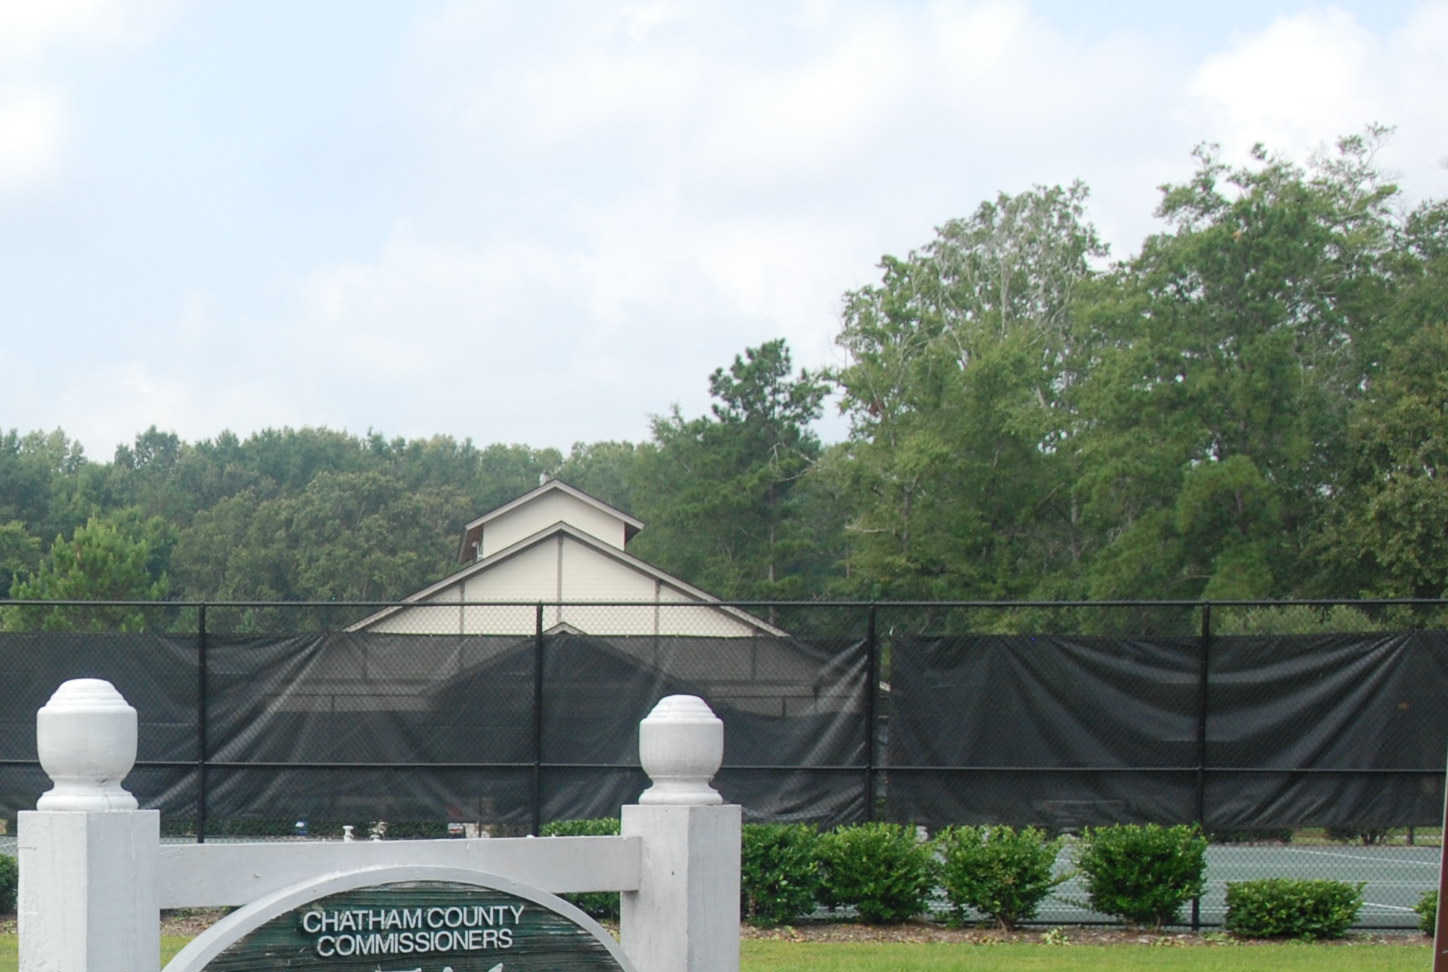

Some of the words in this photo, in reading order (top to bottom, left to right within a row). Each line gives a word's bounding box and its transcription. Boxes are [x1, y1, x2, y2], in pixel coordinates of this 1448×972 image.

[302, 908, 423, 934] CHATHAM
[425, 905, 525, 929] COUNTY
[317, 929, 513, 957] COMMISSIONERS
